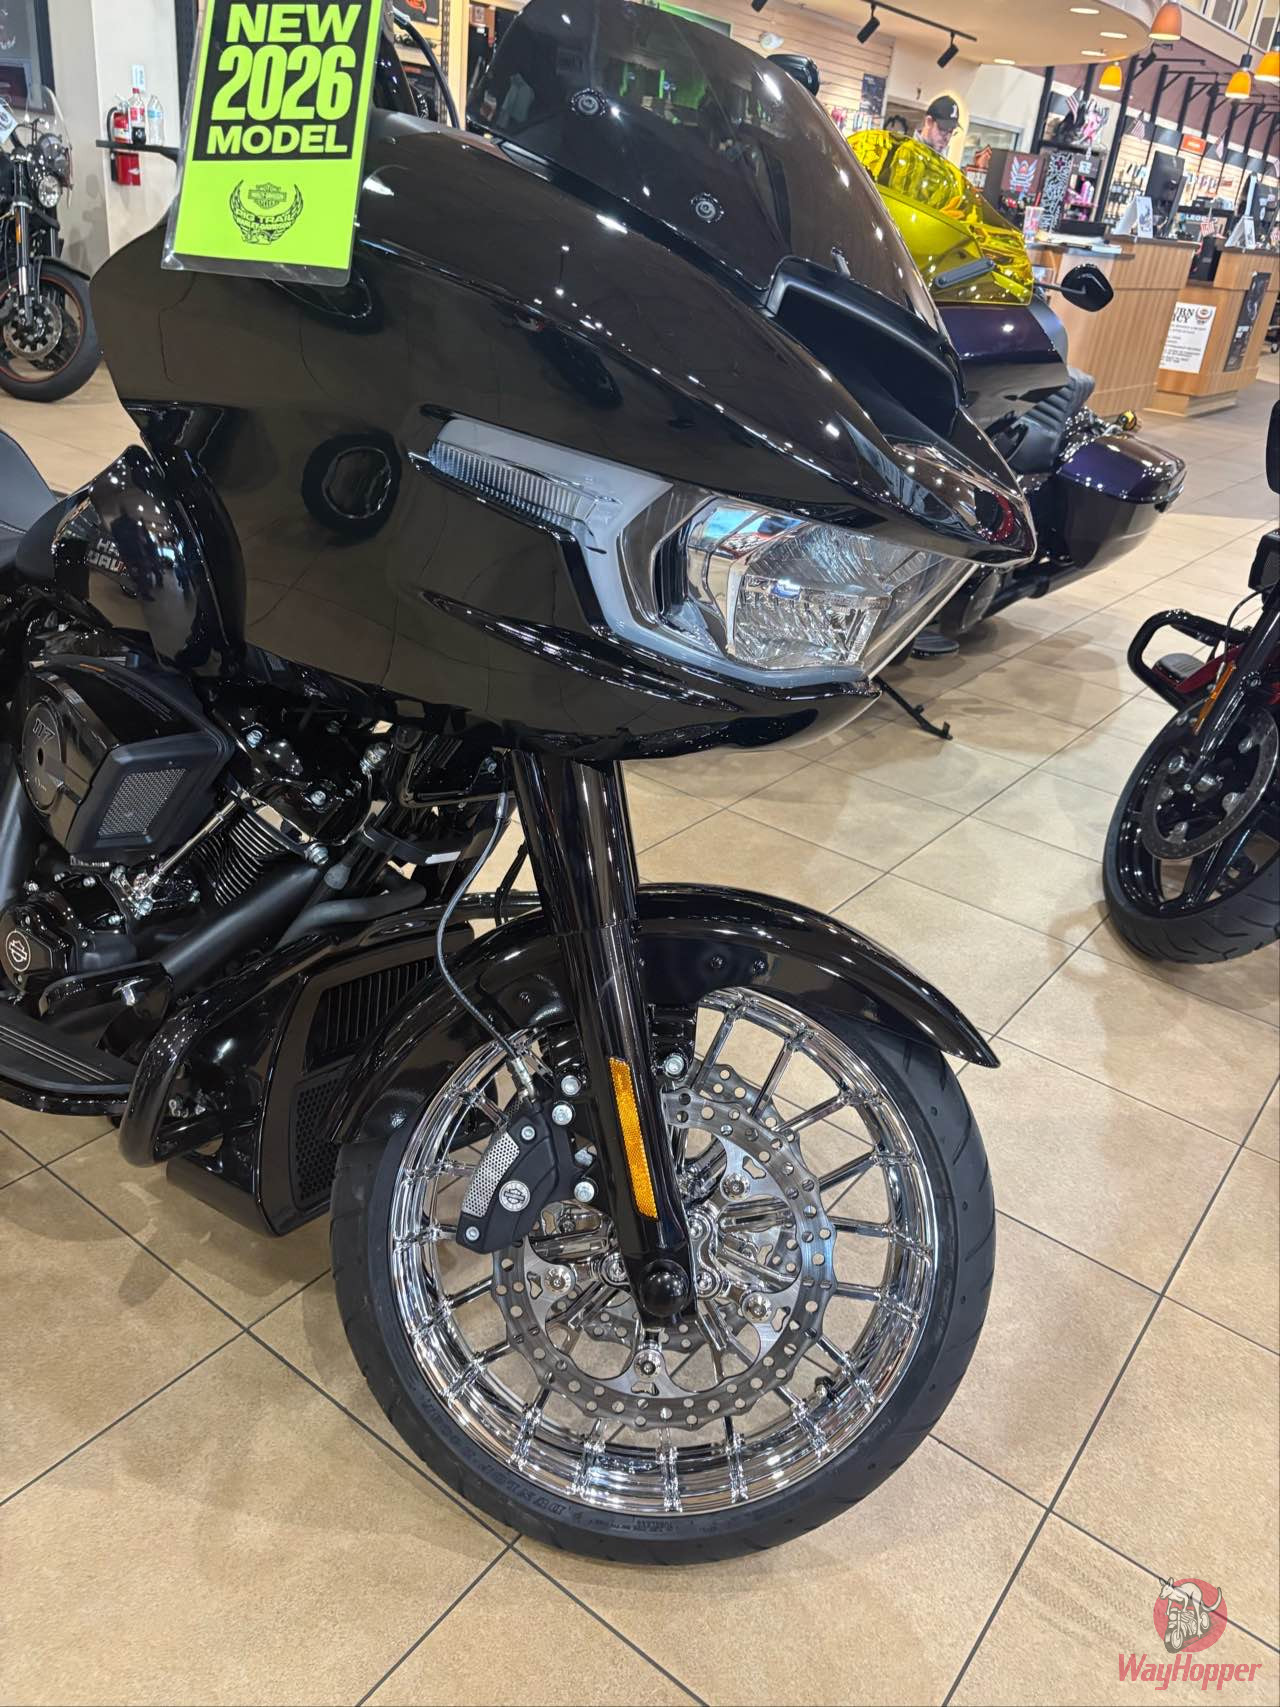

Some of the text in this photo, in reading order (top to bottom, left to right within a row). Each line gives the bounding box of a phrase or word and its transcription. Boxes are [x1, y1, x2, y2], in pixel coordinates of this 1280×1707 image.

[226, 4, 361, 43] NEW
[211, 44, 356, 121] 2026
[207, 125, 348, 154] MODEL
[259, 214, 294, 224] TRAIL
[32, 718, 56, 745] 117
